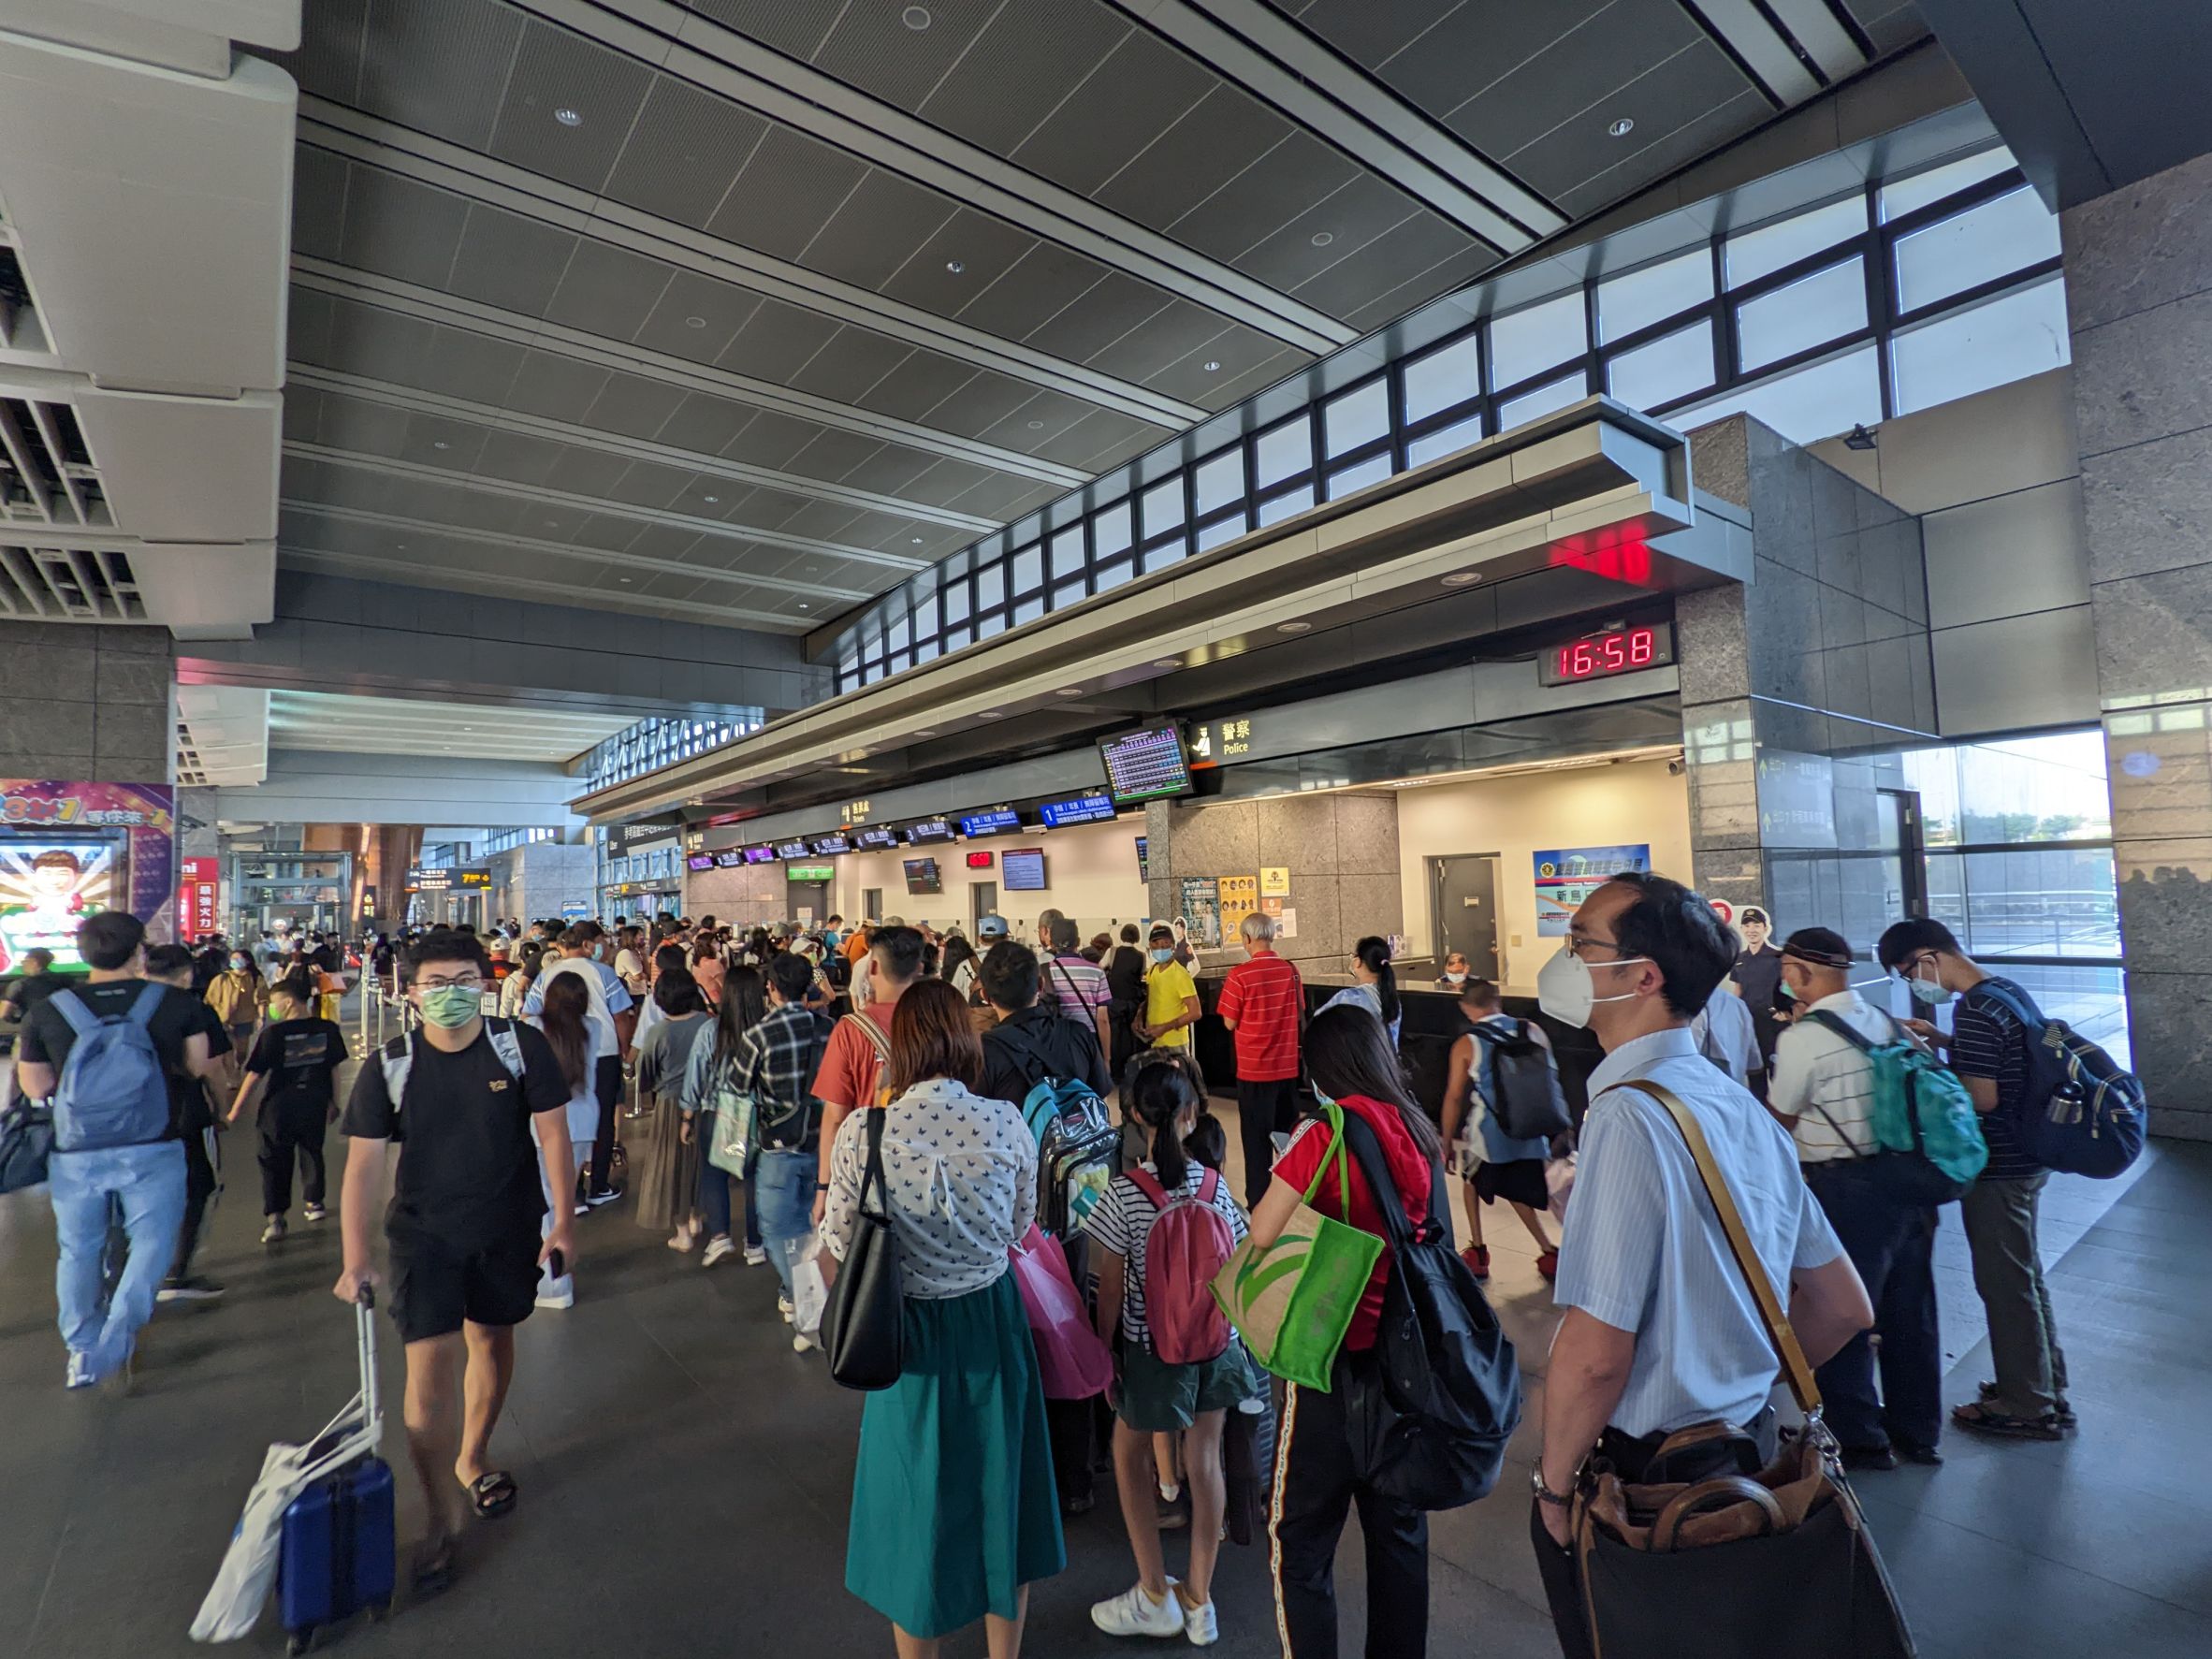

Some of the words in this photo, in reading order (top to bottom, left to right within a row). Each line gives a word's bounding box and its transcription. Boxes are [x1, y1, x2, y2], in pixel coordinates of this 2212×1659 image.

[1561, 630, 1652, 676] 16:58
[1222, 720, 1250, 741] 警察
[1223, 742, 1249, 755] Police
